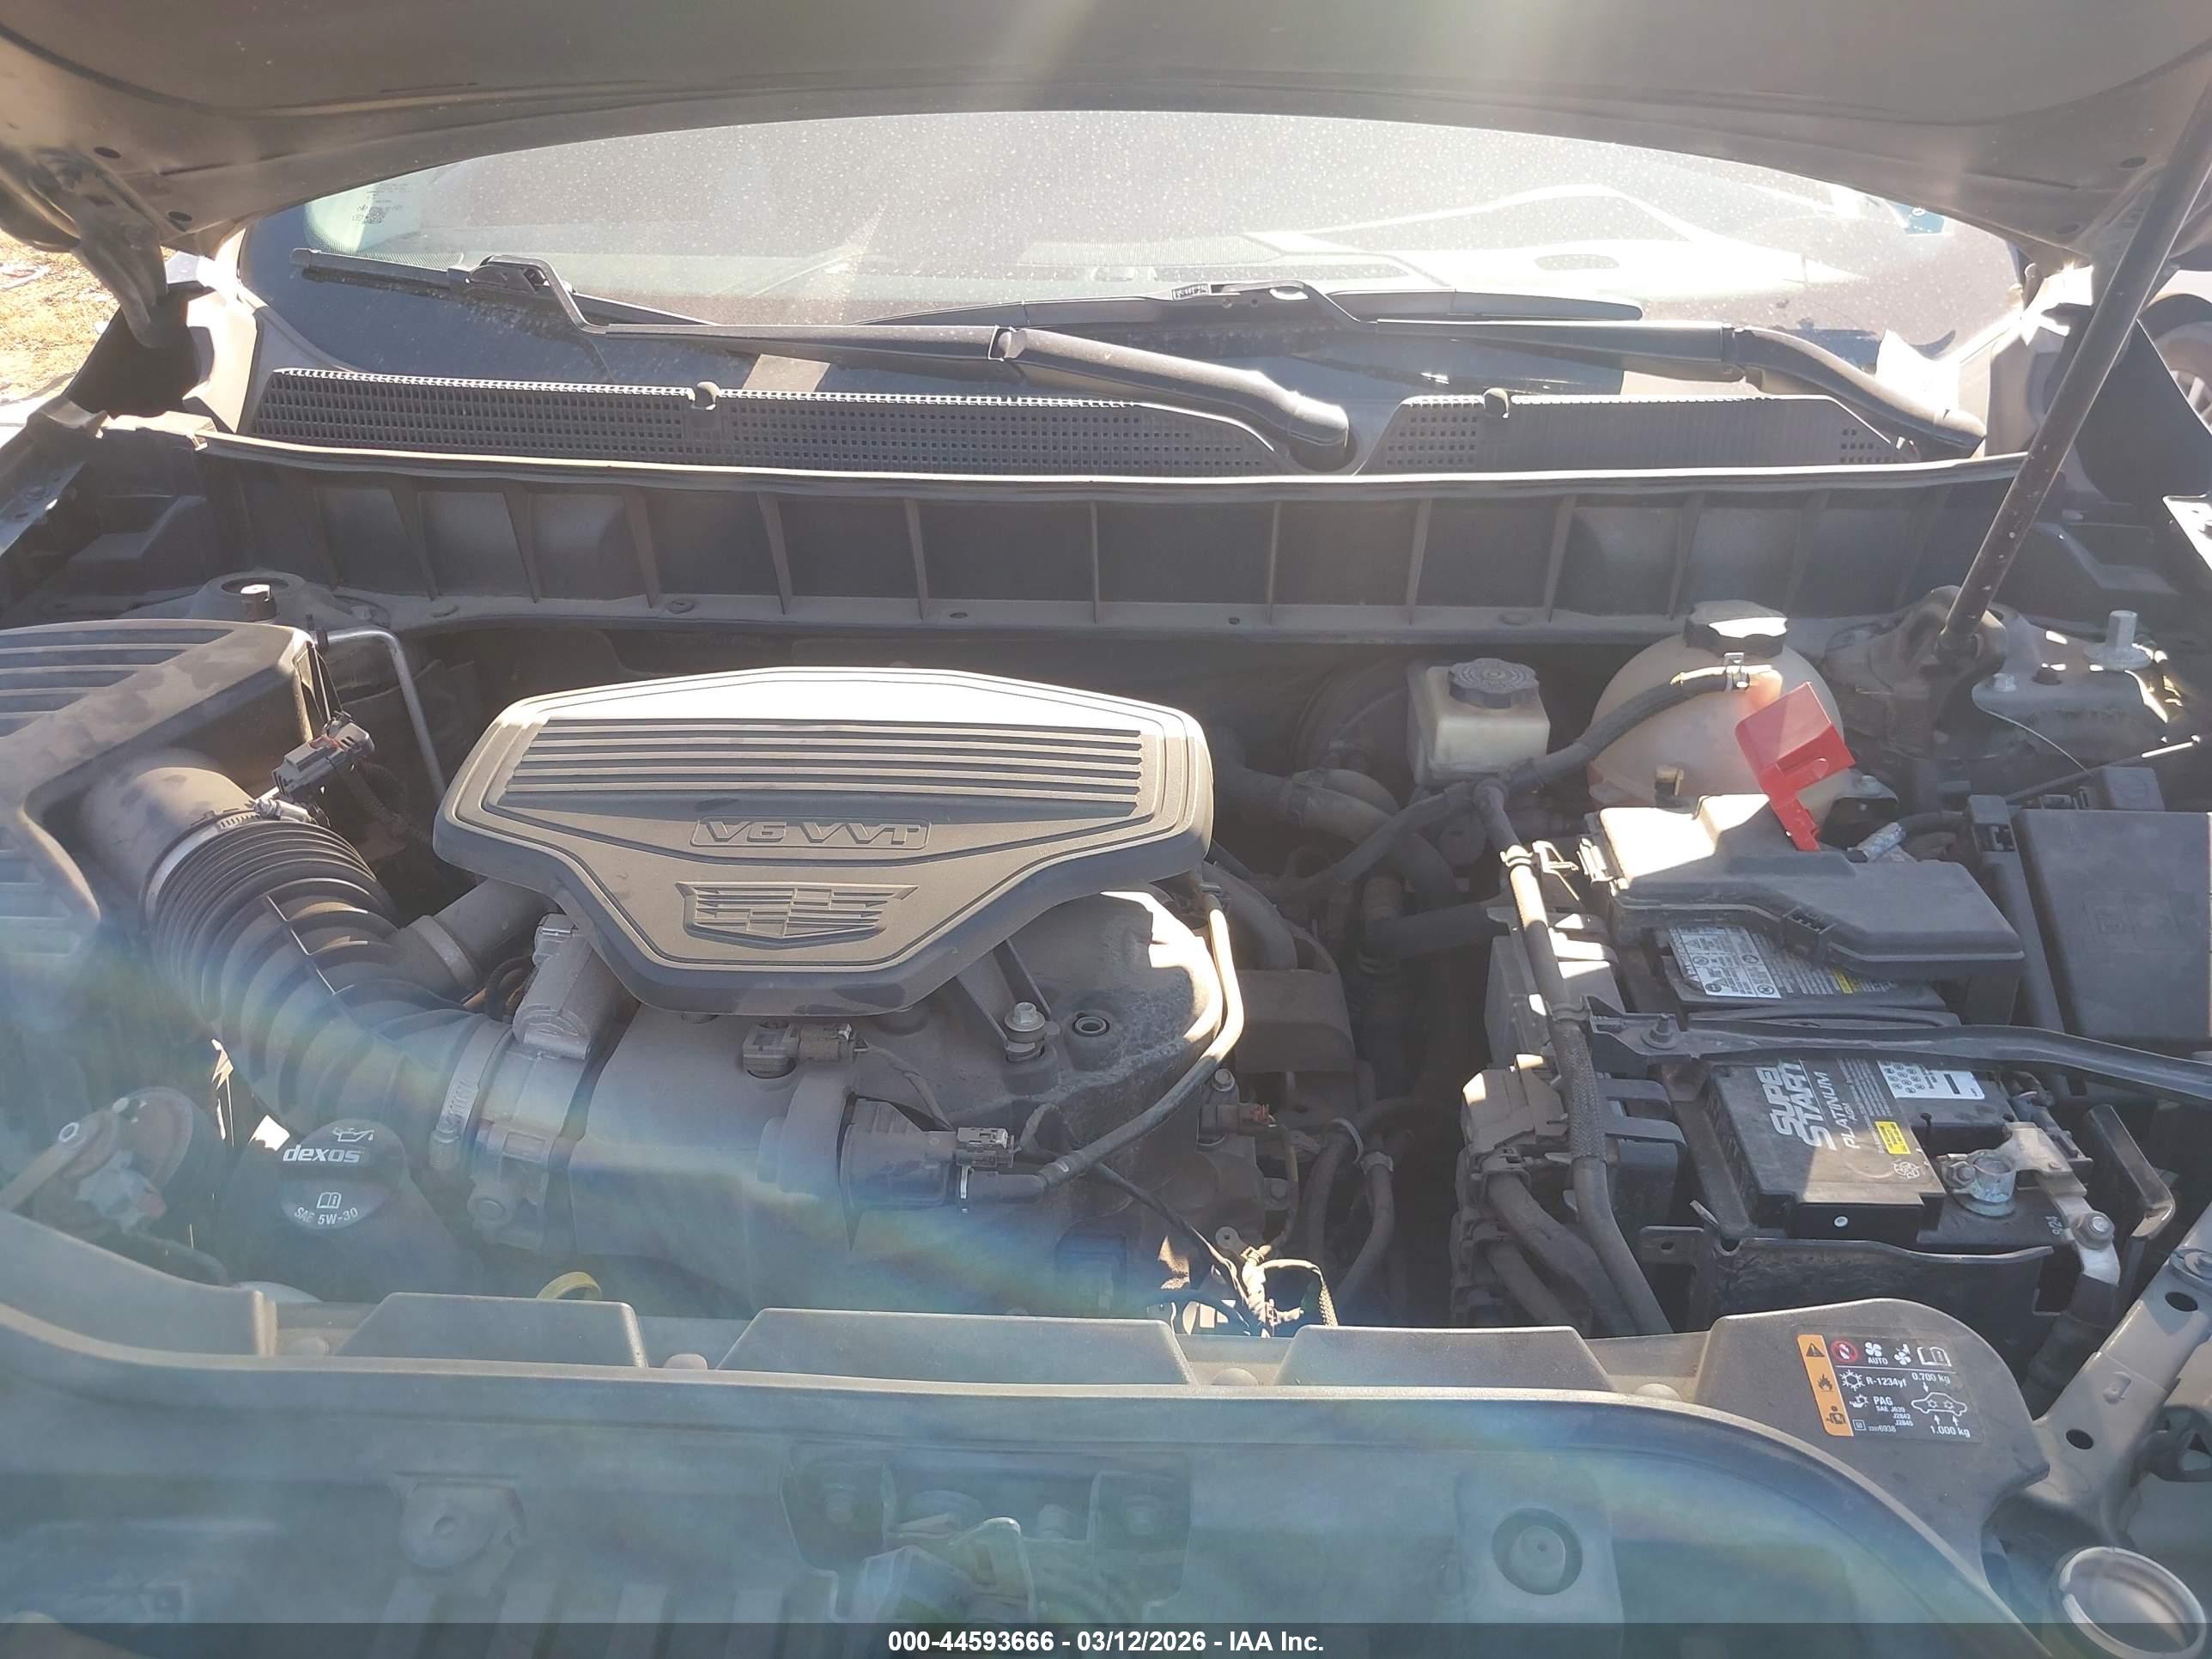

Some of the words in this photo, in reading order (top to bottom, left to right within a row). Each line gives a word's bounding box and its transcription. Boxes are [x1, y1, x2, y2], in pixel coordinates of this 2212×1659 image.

[706, 821, 787, 842] V6
[800, 822, 921, 844] VVT
[1754, 1066, 1796, 1136] SUPE
[1814, 1072, 1861, 1149] PLATINUM
[283, 1145, 363, 1163] dexos
[294, 1206, 314, 1223] SAE
[318, 1208, 358, 1225] 5W-30
[1868, 1357, 1888, 1365] AUTO
[1865, 1376, 1907, 1389] R-1234yf
[1911, 1372, 1936, 1382] 0.700
[1938, 1375, 1951, 1384] kg
[1873, 1396, 1893, 1406] PAG
[1930, 1425, 1956, 1435] 1.000
[1958, 1428, 1971, 1437] kg
